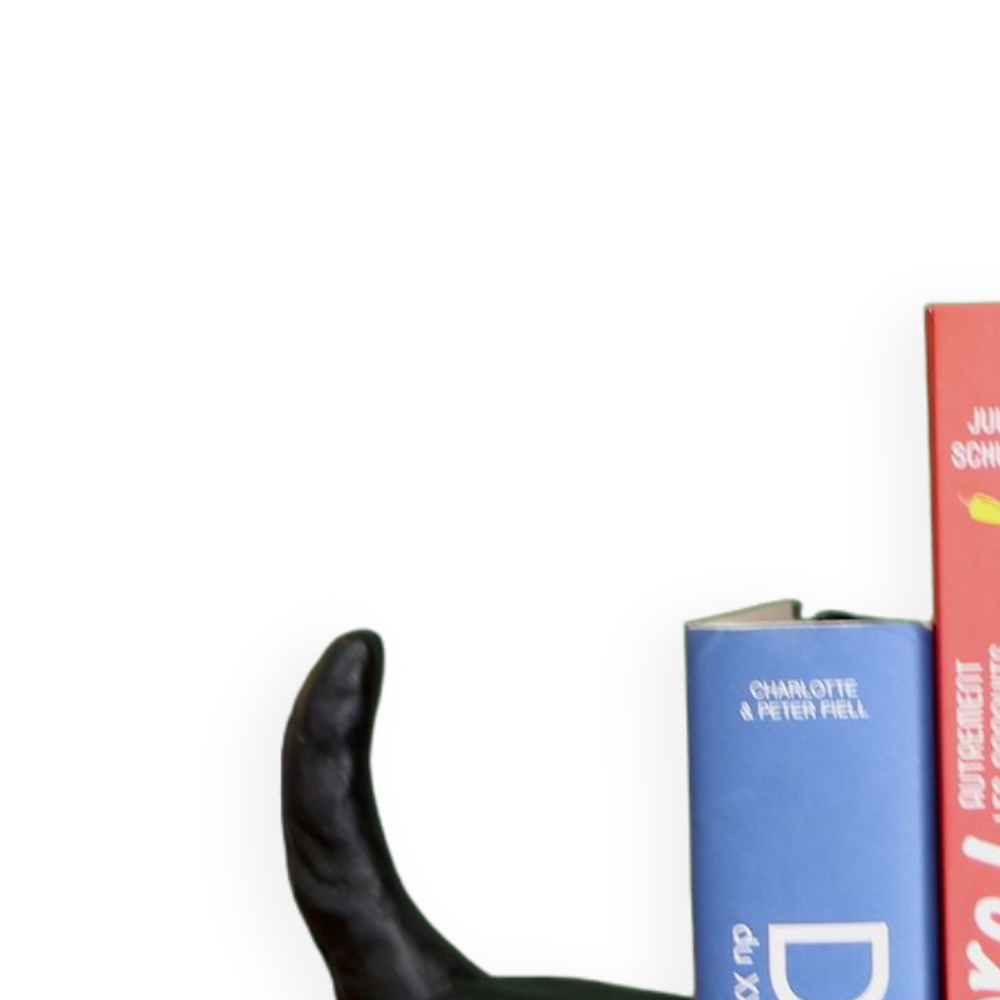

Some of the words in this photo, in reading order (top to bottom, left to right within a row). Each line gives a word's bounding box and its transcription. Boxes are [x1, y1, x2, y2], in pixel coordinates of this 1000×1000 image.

[749, 678, 858, 700] CHARLOTTE
[739, 700, 754, 721] &
[757, 700, 816, 720] PETER
[820, 699, 870, 719] FIELL
[956, 658, 986, 811] AUTREMENT
[732, 923, 760, 965] du
